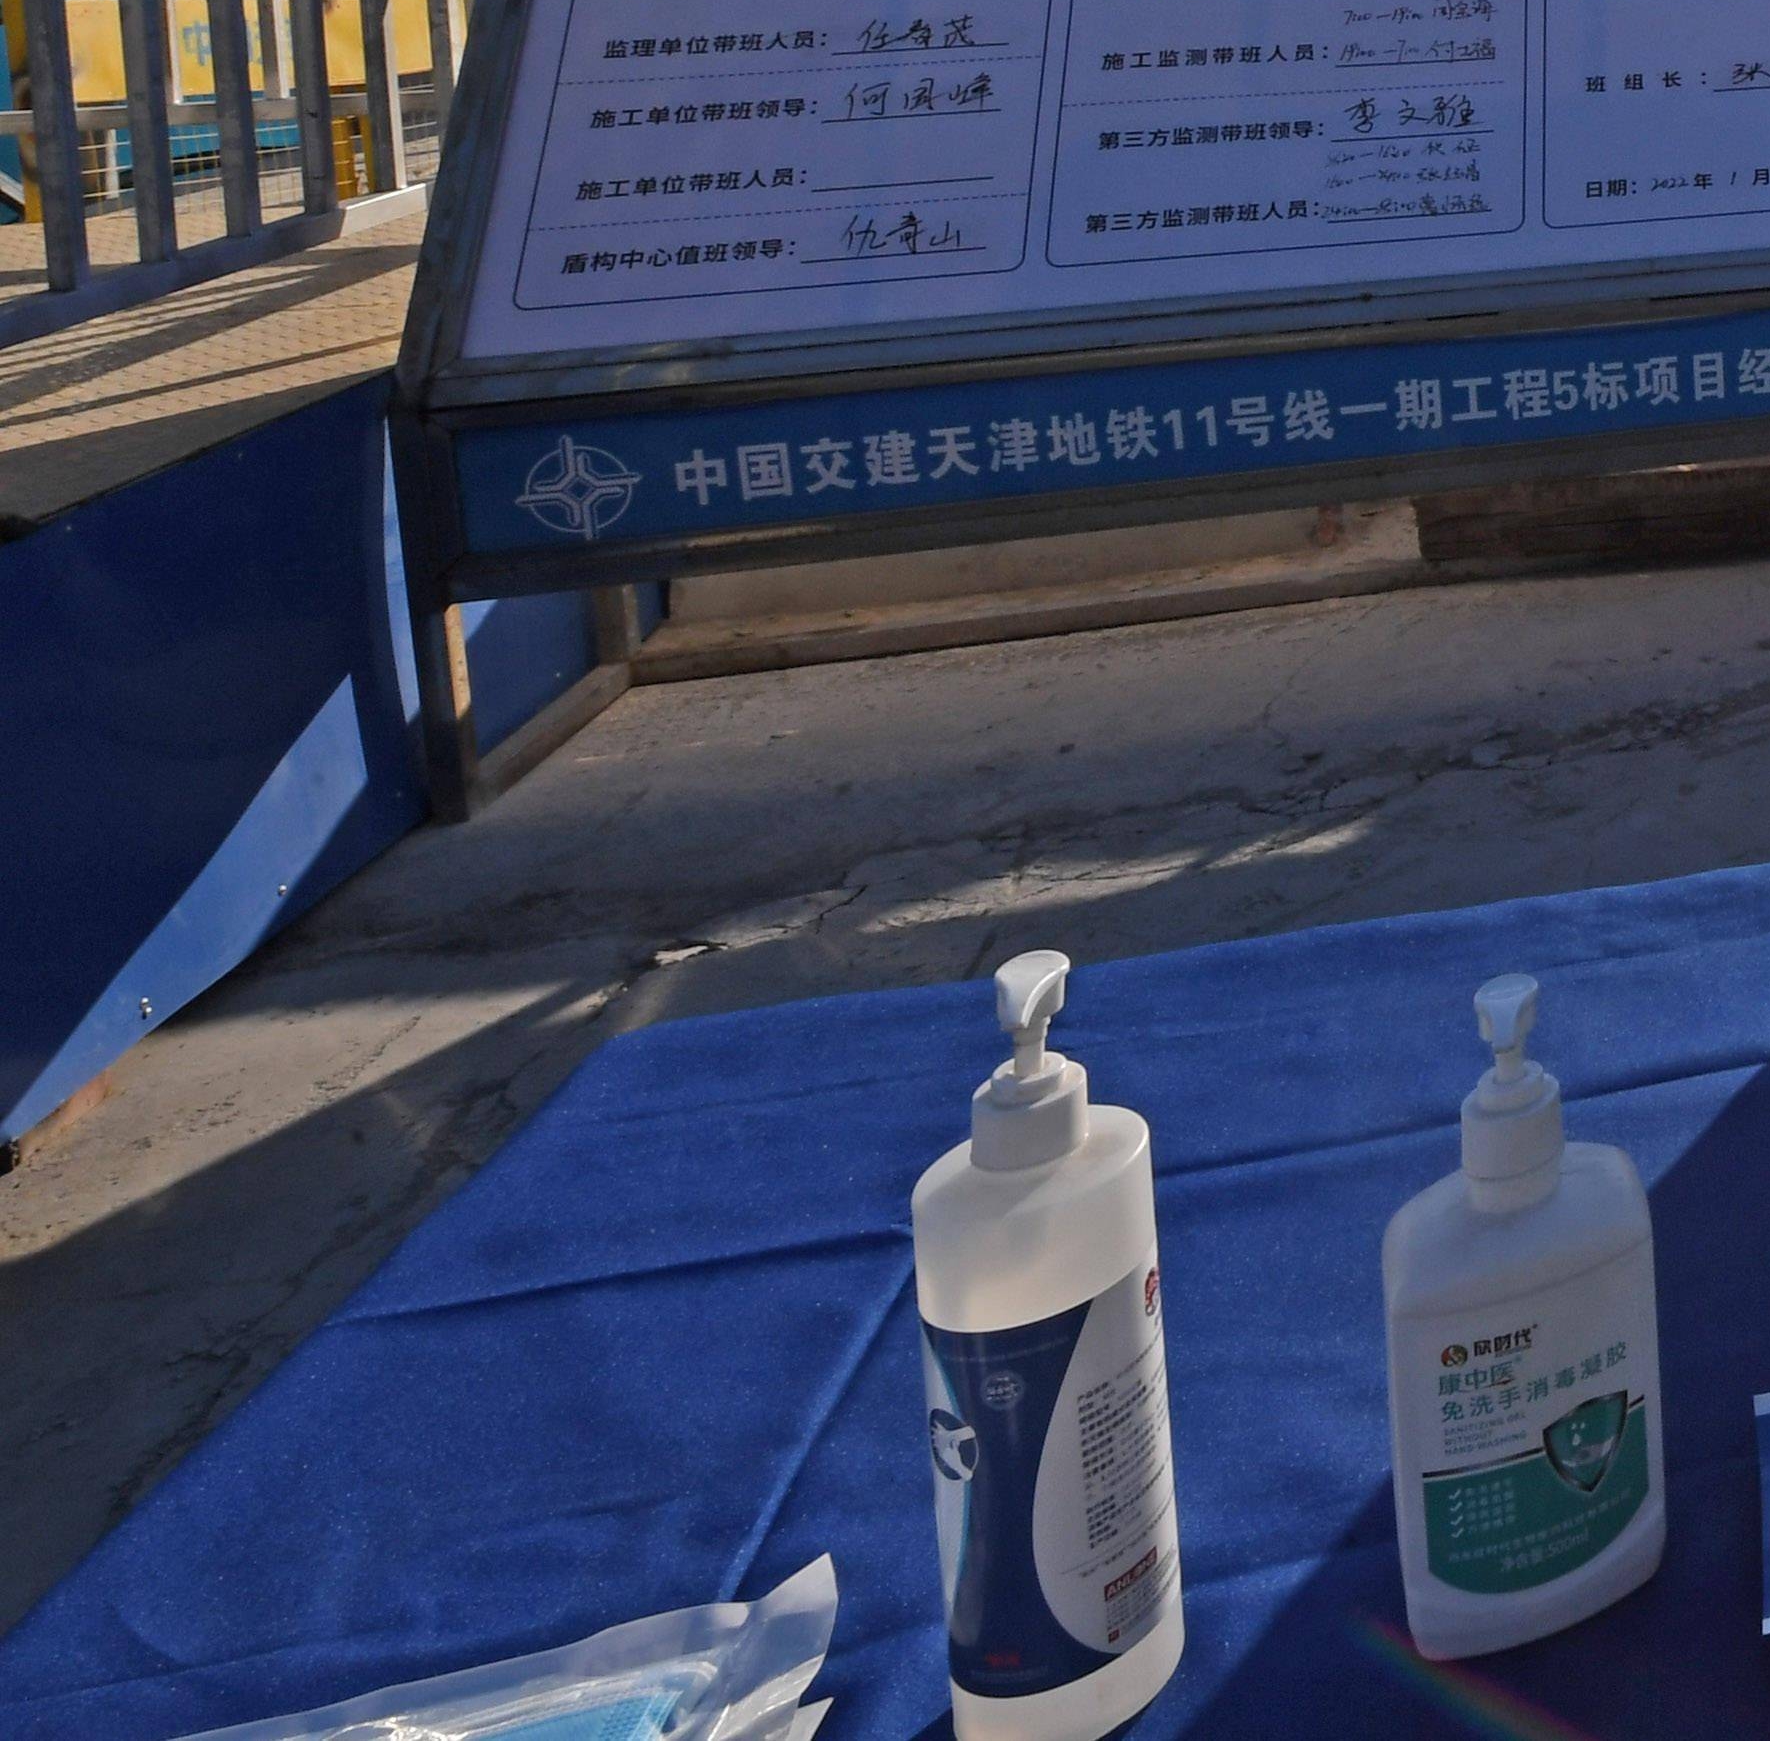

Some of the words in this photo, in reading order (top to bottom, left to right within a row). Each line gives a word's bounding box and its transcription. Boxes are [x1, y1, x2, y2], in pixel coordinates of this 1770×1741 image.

[602, 28, 829, 60] 监理单位带班人员：
[1100, 43, 1330, 72] 施工监测带班人员：
[589, 97, 820, 131] 施工单位带班领导：
[1097, 119, 1326, 152] 第三方监测带班领导：
[574, 167, 808, 204] 施工单位带班人员：
[1083, 198, 1322, 235] 第三方监测带班人员：
[559, 236, 800, 275] 盾构中心值班领导：
[1440, 1340, 1628, 1423] 免洗手消毒凝胶
